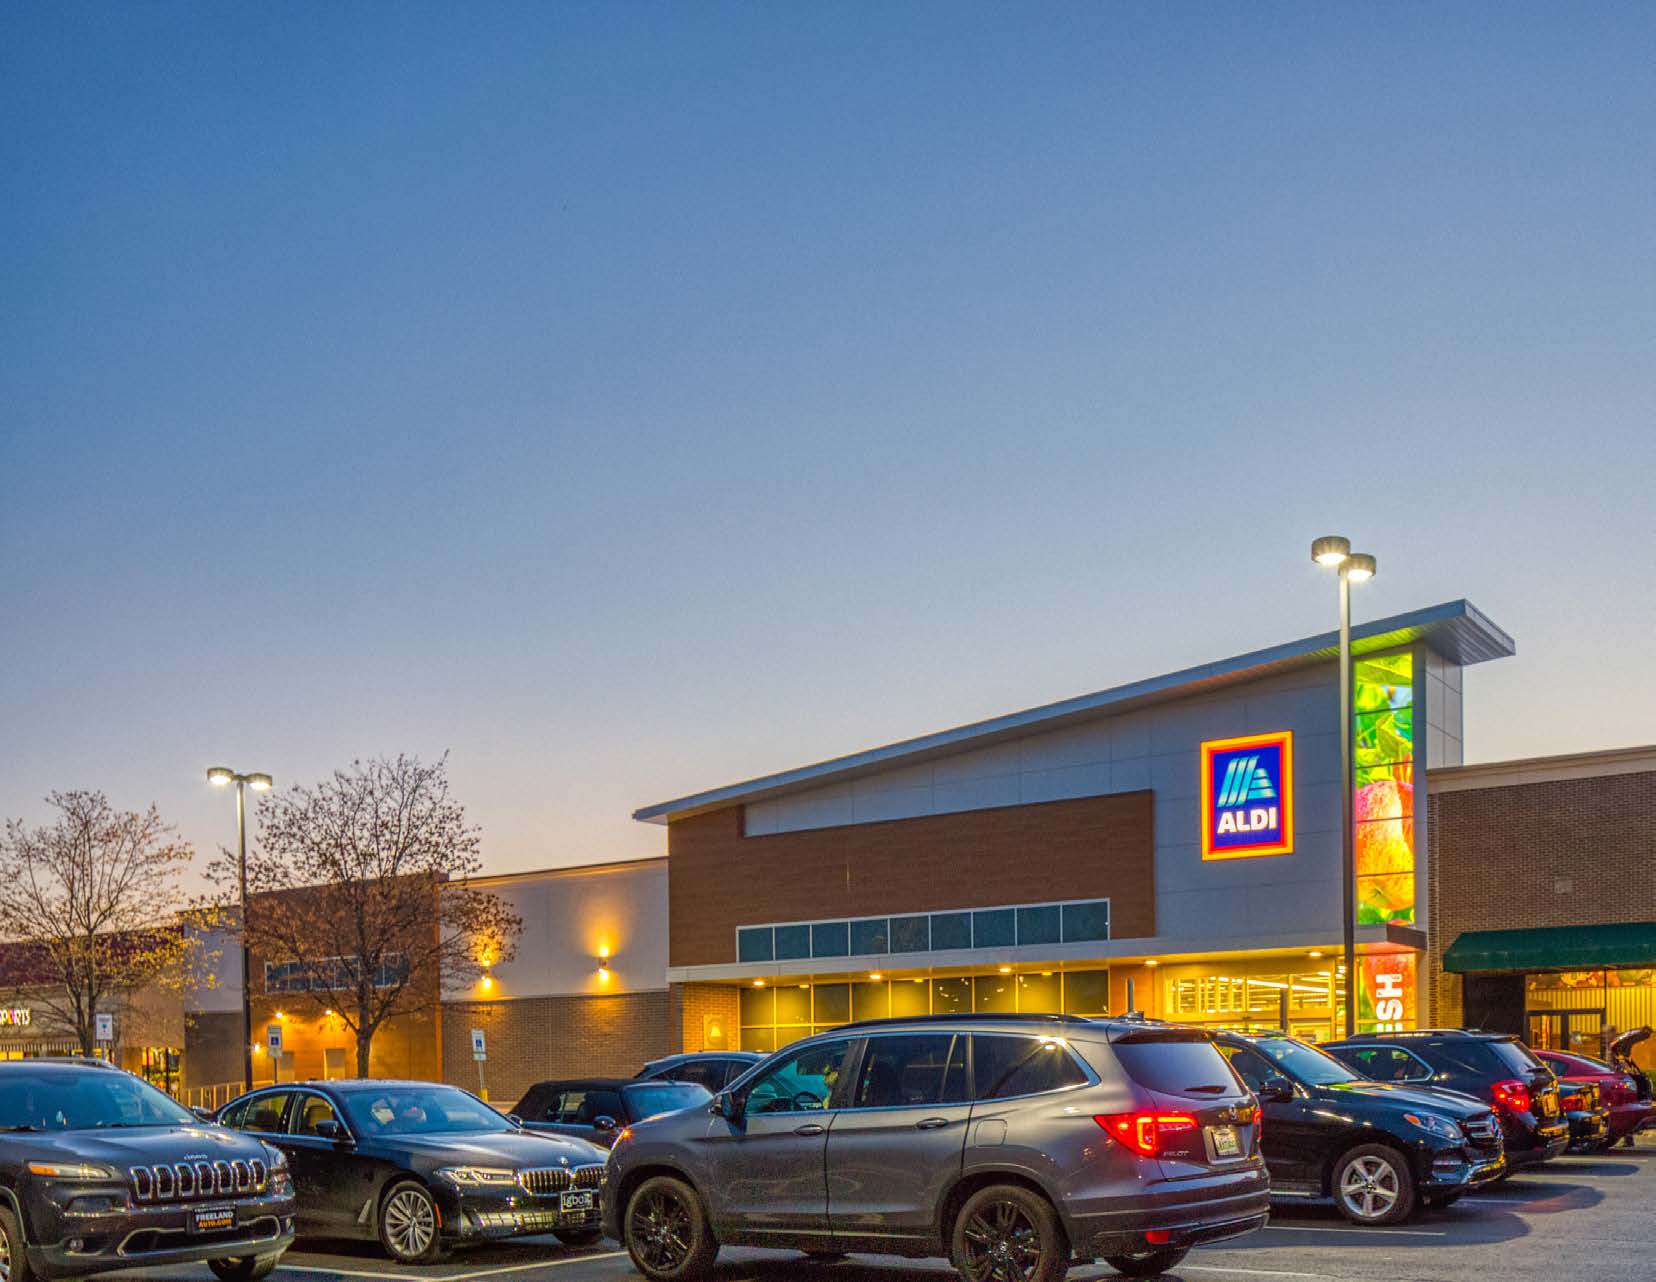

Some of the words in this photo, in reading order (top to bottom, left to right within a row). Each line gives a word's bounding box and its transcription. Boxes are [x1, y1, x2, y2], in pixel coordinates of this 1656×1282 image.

[1217, 807, 1277, 834] ALDI
[0, 1008, 31, 1026] PORTS
[195, 1211, 234, 1221] FREELAND
